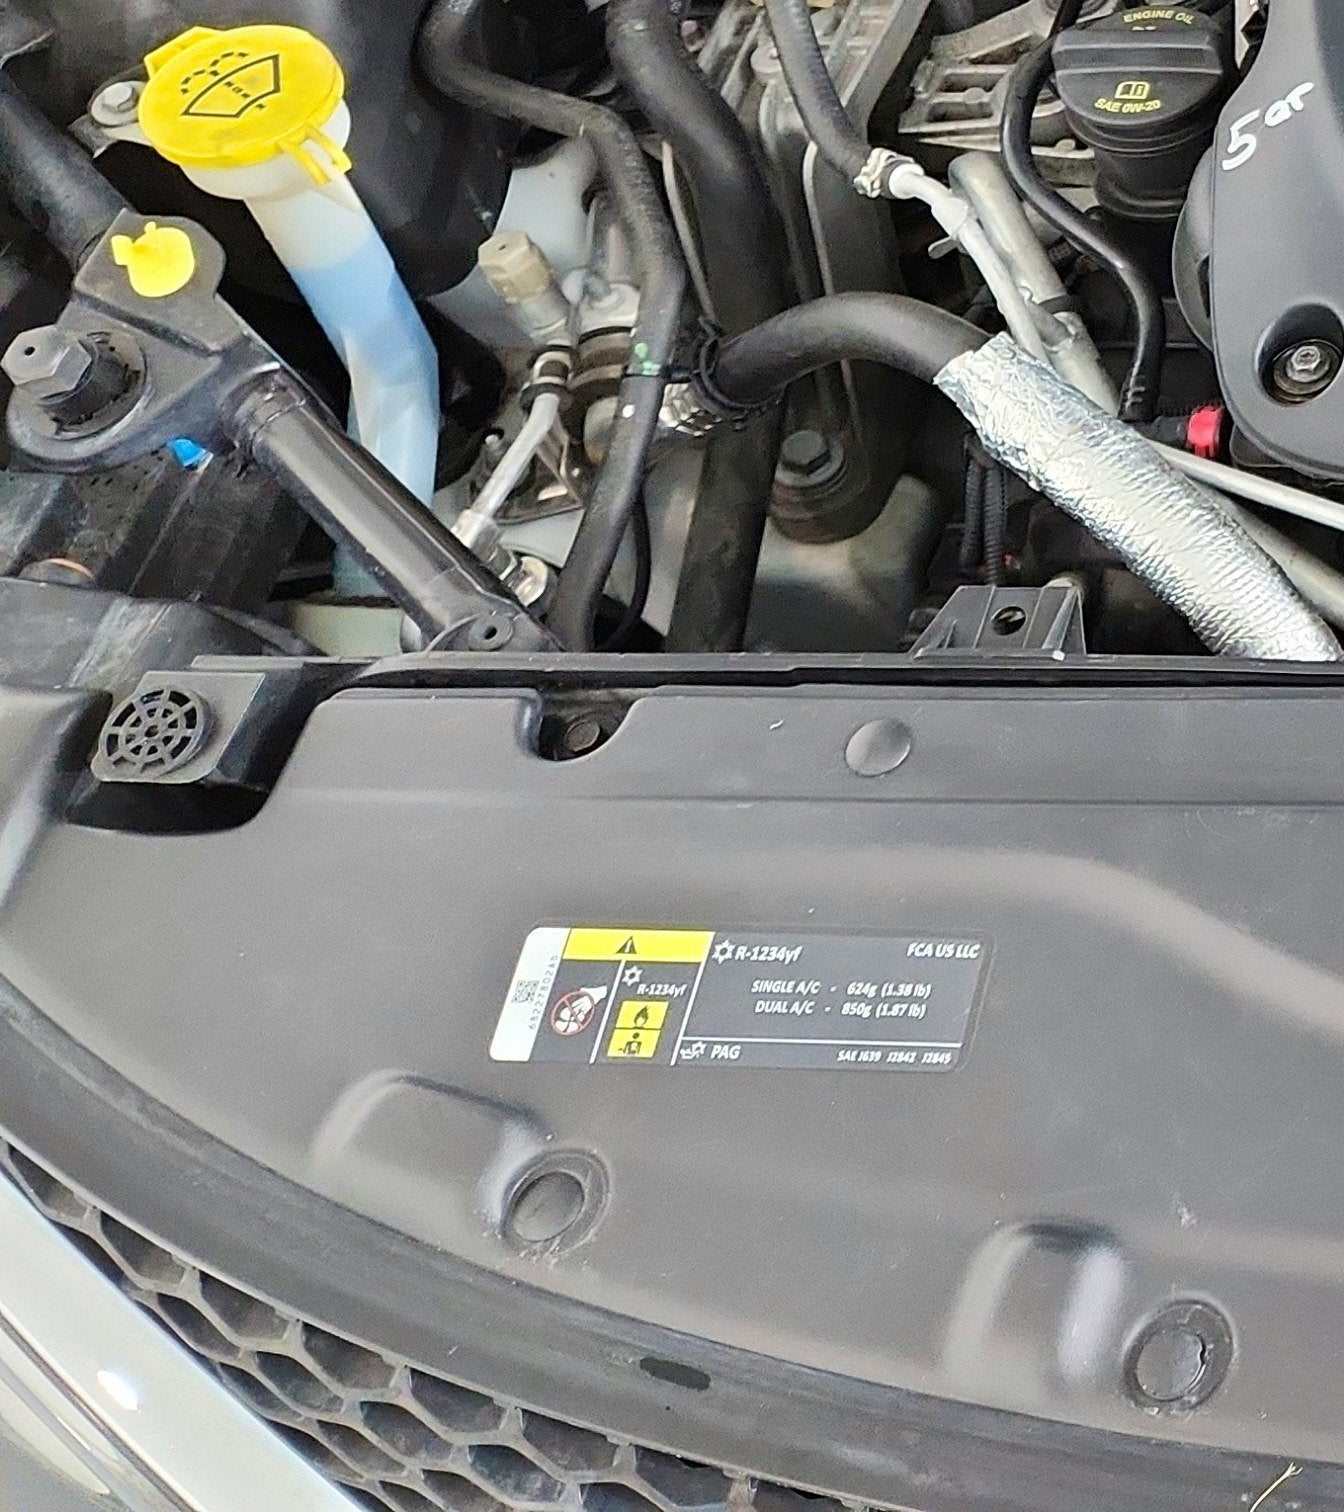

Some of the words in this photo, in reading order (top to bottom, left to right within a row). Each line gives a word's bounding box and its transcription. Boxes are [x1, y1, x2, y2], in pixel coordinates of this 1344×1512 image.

[1123, 10, 1175, 24] ENGINE
[1175, 11, 1194, 25] OIL
[1094, 97, 1122, 113] SAE
[1121, 98, 1162, 115] 0W-20
[735, 944, 803, 965] R-1234yf
[906, 942, 934, 958] FCA
[935, 944, 955, 958] US
[956, 944, 981, 959] LLC
[636, 983, 688, 1000] R-1234yf
[751, 979, 794, 994] SINGLE
[795, 980, 821, 995] A/C
[847, 982, 877, 999] 624g
[755, 1000, 789, 1014] DUAL
[790, 1000, 816, 1015] A/C
[841, 1003, 872, 1019] 850g
[875, 1002, 908, 1019] (1.87
[710, 1044, 741, 1060] PAG
[837, 1050, 858, 1062] SAE
